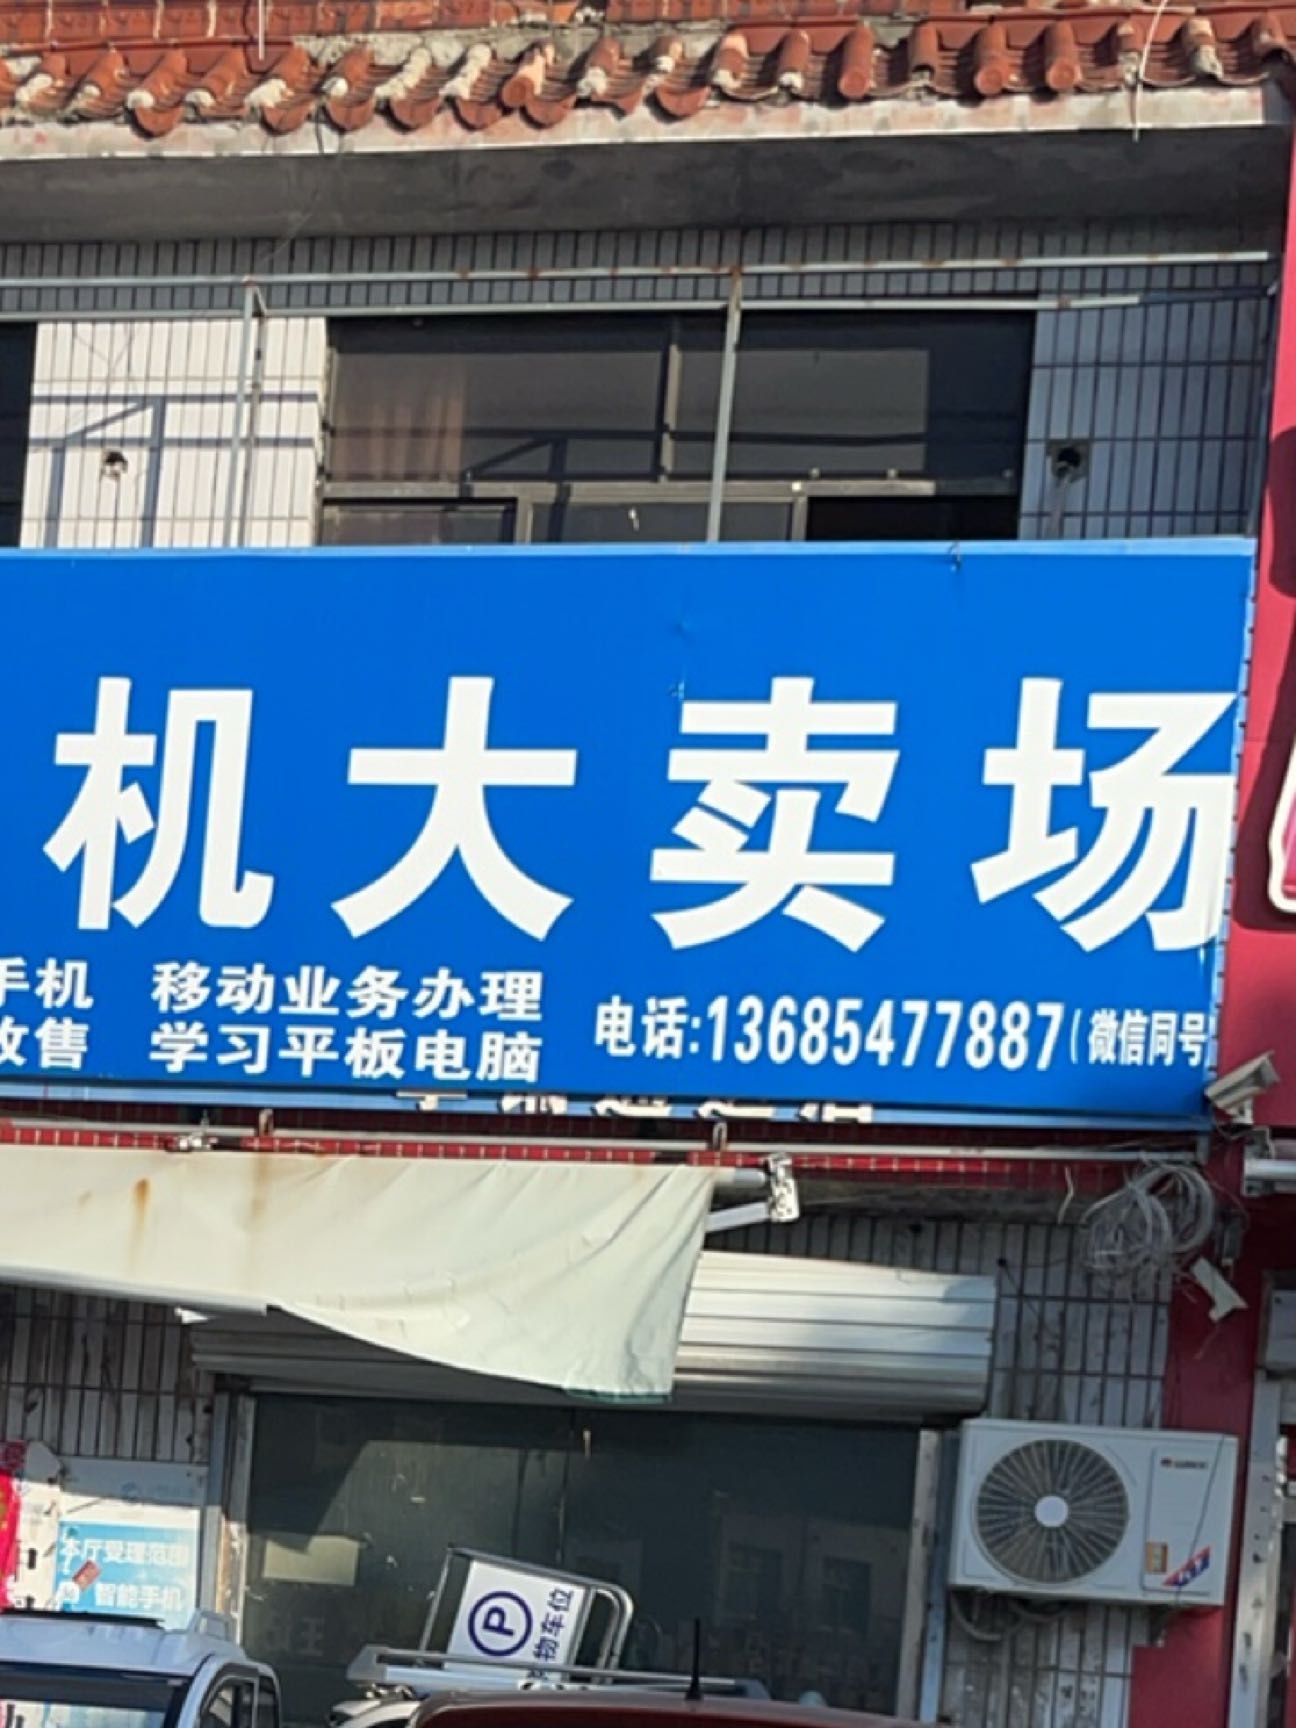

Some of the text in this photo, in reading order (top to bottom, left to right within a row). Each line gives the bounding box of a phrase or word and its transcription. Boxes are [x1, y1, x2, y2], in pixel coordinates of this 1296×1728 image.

[150, 960, 543, 1022] 移动业务办理
[149, 1020, 543, 1083] 学习平板电脑
